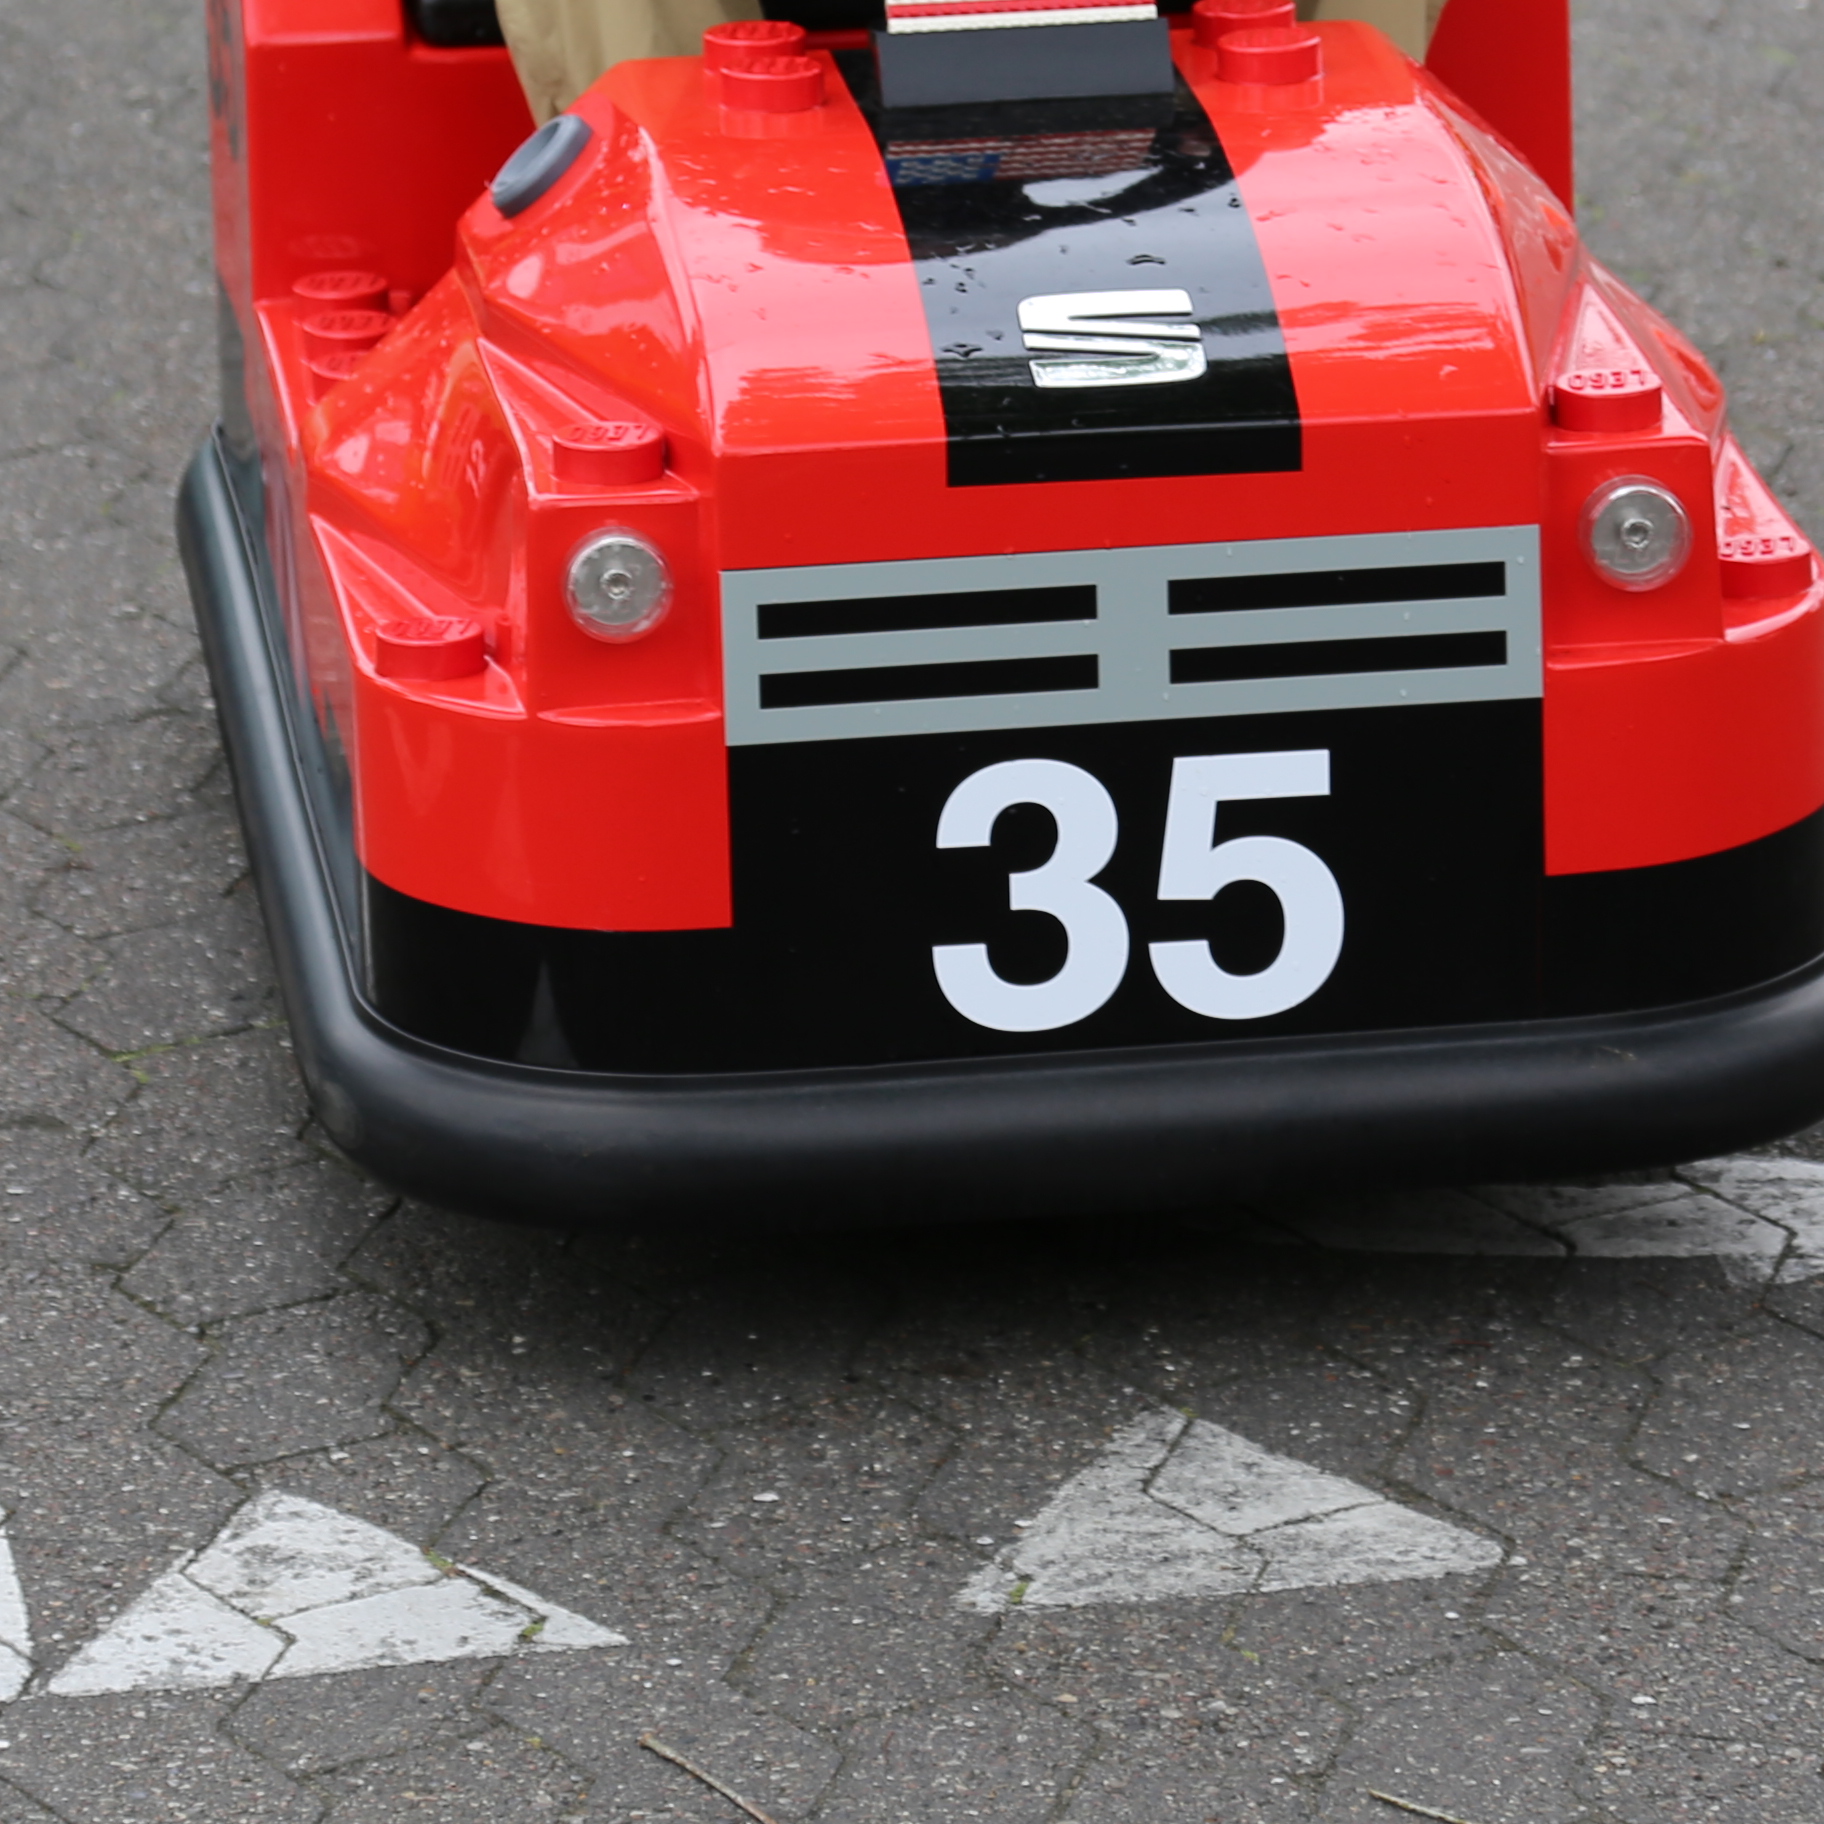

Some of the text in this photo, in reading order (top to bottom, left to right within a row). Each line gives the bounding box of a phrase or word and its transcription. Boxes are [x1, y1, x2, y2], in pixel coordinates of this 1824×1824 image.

[1568, 369, 1645, 391] LEGO
[1719, 536, 1794, 557] LEGO
[933, 750, 1344, 1031] 35
